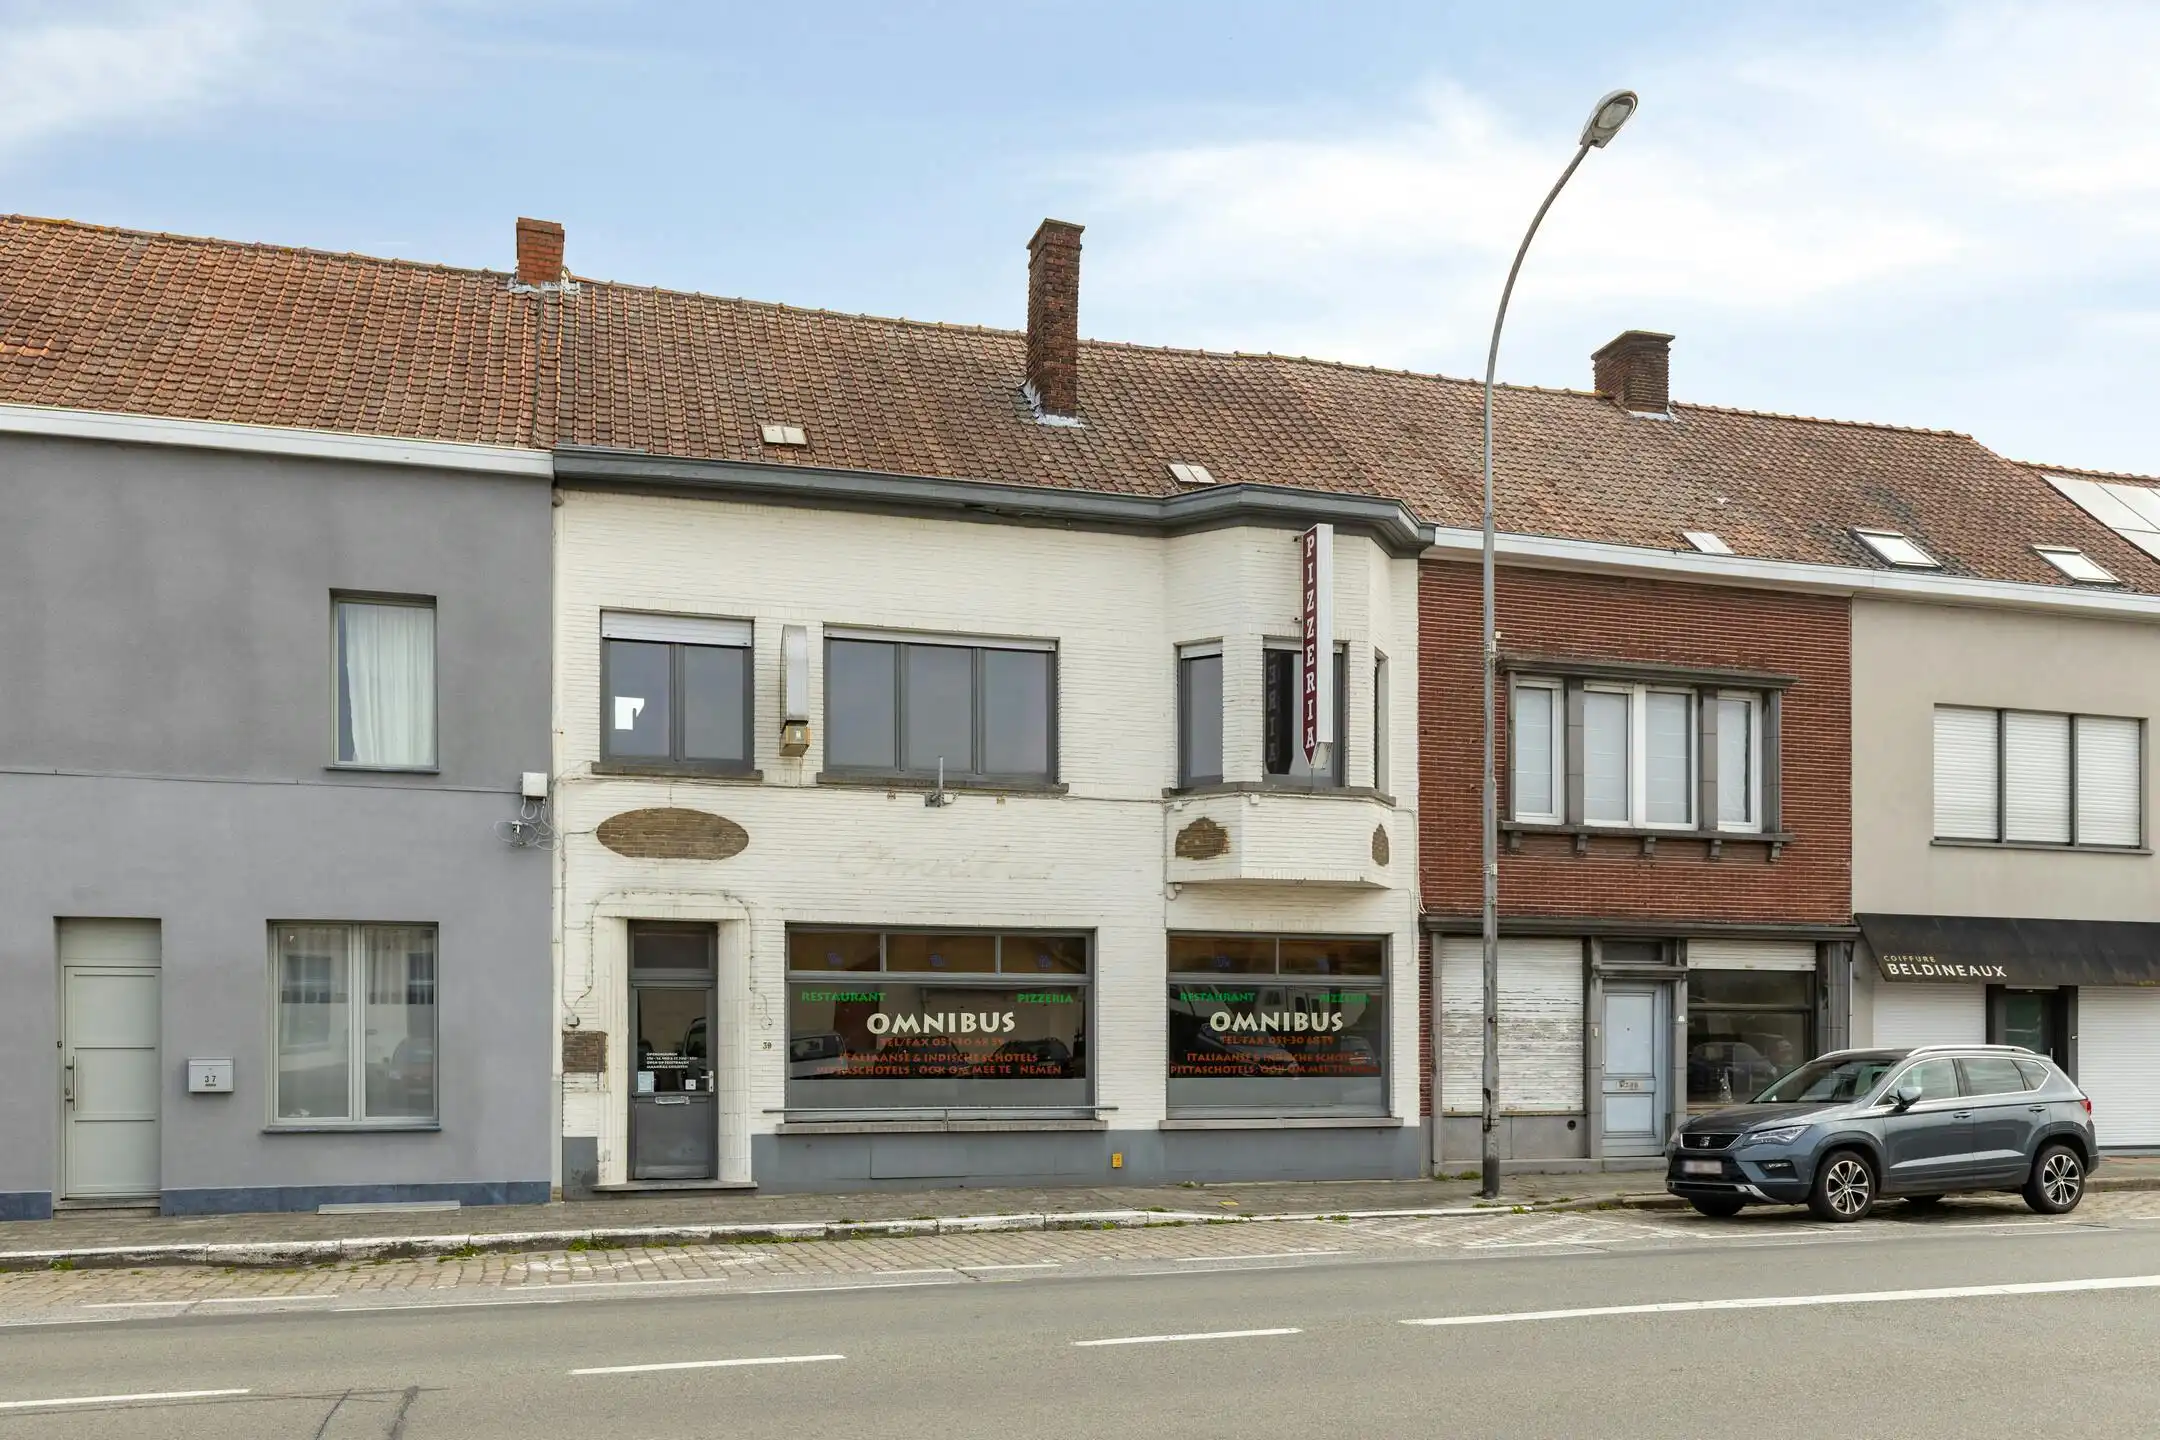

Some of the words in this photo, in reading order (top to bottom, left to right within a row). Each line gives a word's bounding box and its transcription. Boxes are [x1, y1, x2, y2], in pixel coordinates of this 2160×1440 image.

[1306, 534, 1315, 749] PIZZERIA
[1883, 954, 1937, 963] COIFFURE
[1887, 962, 2008, 978] BELDINEAUX
[801, 991, 887, 1002] RESTAURANT
[1017, 993, 1074, 1004] PIZZERIA
[1179, 992, 1255, 1003] RESTAURANT
[866, 1011, 1016, 1034] OMNIBUS
[1209, 1011, 1344, 1032] OMNIBUS
[924, 1053, 979, 1063] INDISCHE
[982, 1052, 1038, 1062] SCHOTELS
[1187, 1052, 1251, 1062] ITALIAANSE
[1263, 1052, 1314, 1062] INCHE
[1316, 1052, 1364, 1062] SCHOT
[972, 1065, 995, 1075] MEE
[999, 1065, 1011, 1075] TE
[1019, 1064, 1062, 1075] NEMEN
[1170, 1065, 1254, 1074] PITTASCHOTELS
[204, 1075, 217, 1083] 37
